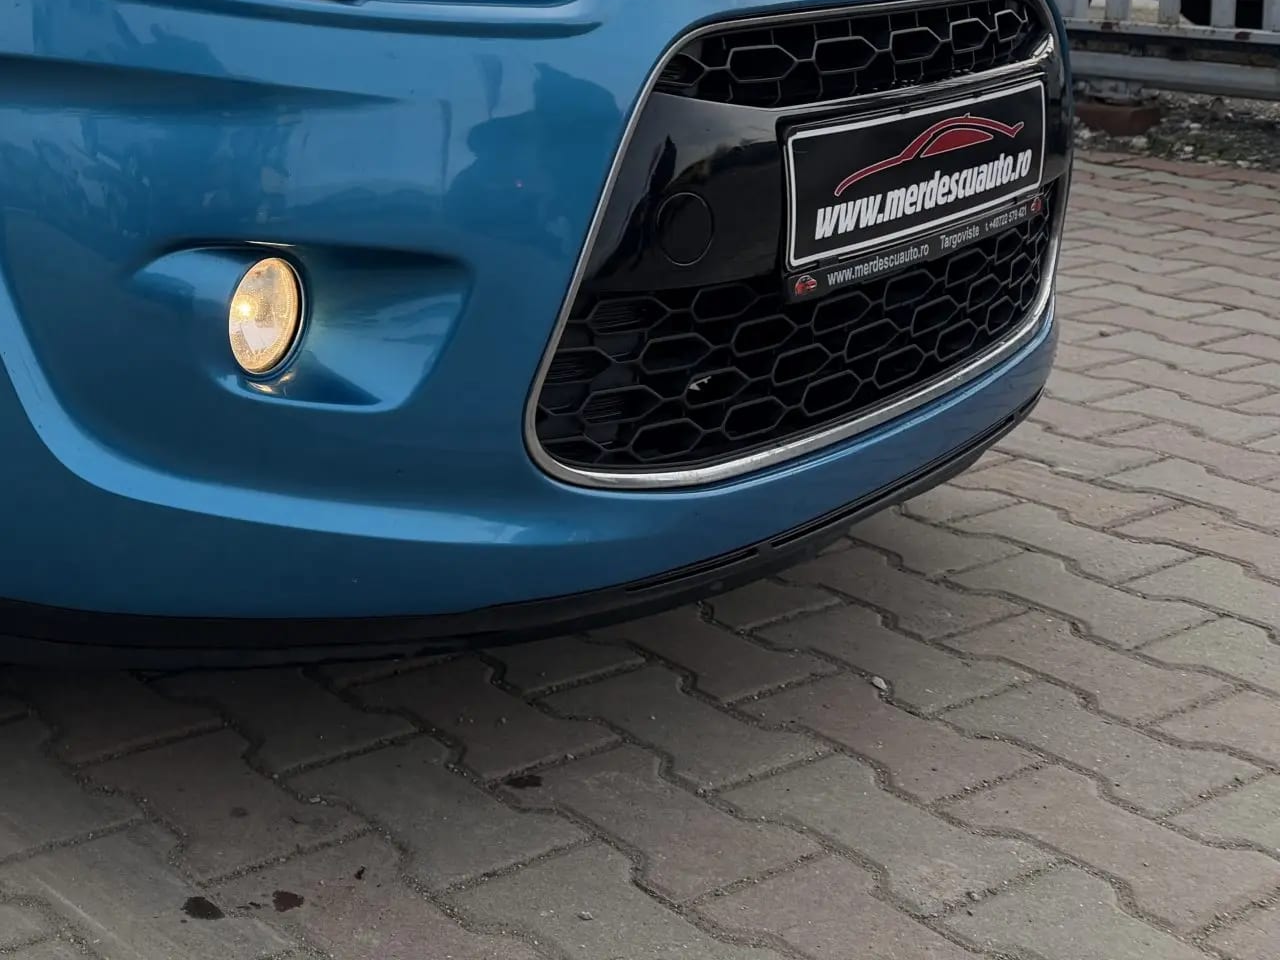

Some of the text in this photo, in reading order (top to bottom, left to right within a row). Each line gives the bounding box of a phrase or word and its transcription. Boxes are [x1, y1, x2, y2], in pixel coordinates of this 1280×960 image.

[814, 148, 1032, 240] www.merdescuauto.ro
[827, 244, 929, 286] www.merdescuauto.ro
[939, 224, 980, 250] Targoviste
